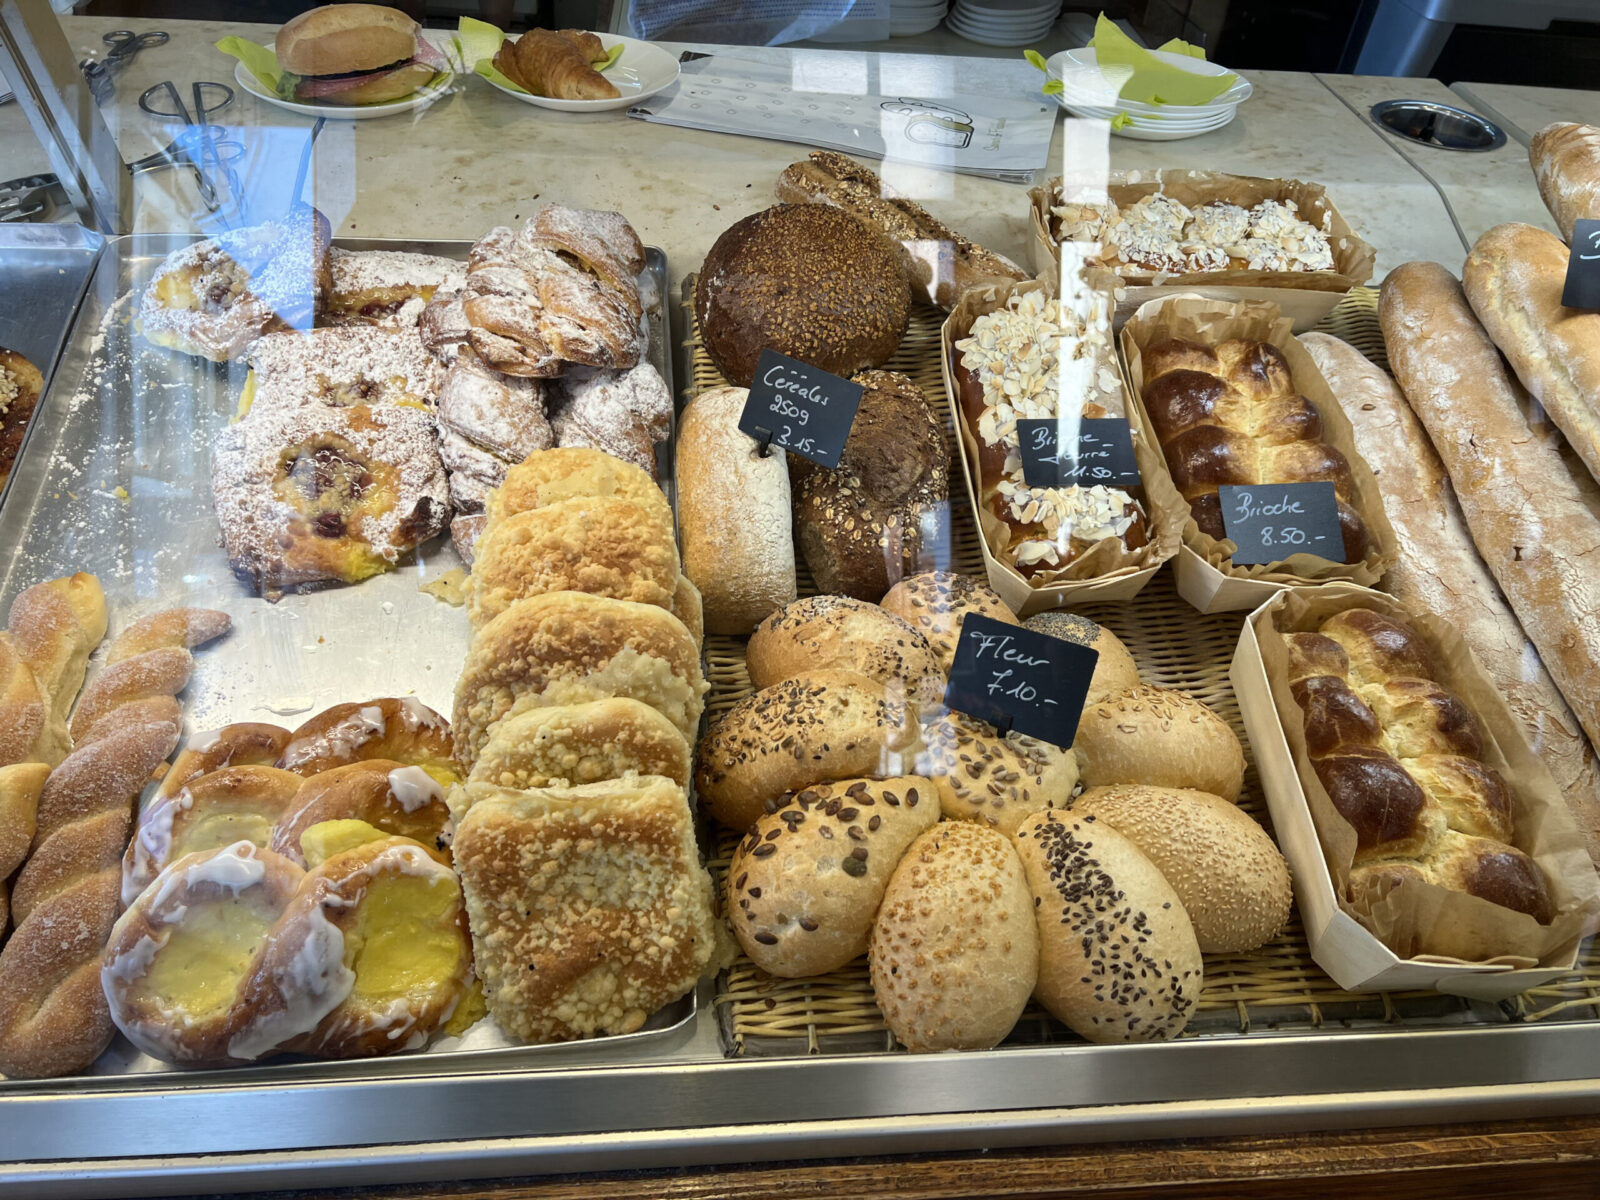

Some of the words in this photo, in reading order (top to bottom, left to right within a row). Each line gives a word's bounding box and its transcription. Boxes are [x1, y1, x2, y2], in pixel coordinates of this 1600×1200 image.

[769, 394, 810, 426] 250g
[1031, 426, 1101, 451] Brie
[1232, 492, 1305, 524] Brioche
[969, 631, 1051, 666] Fleur
